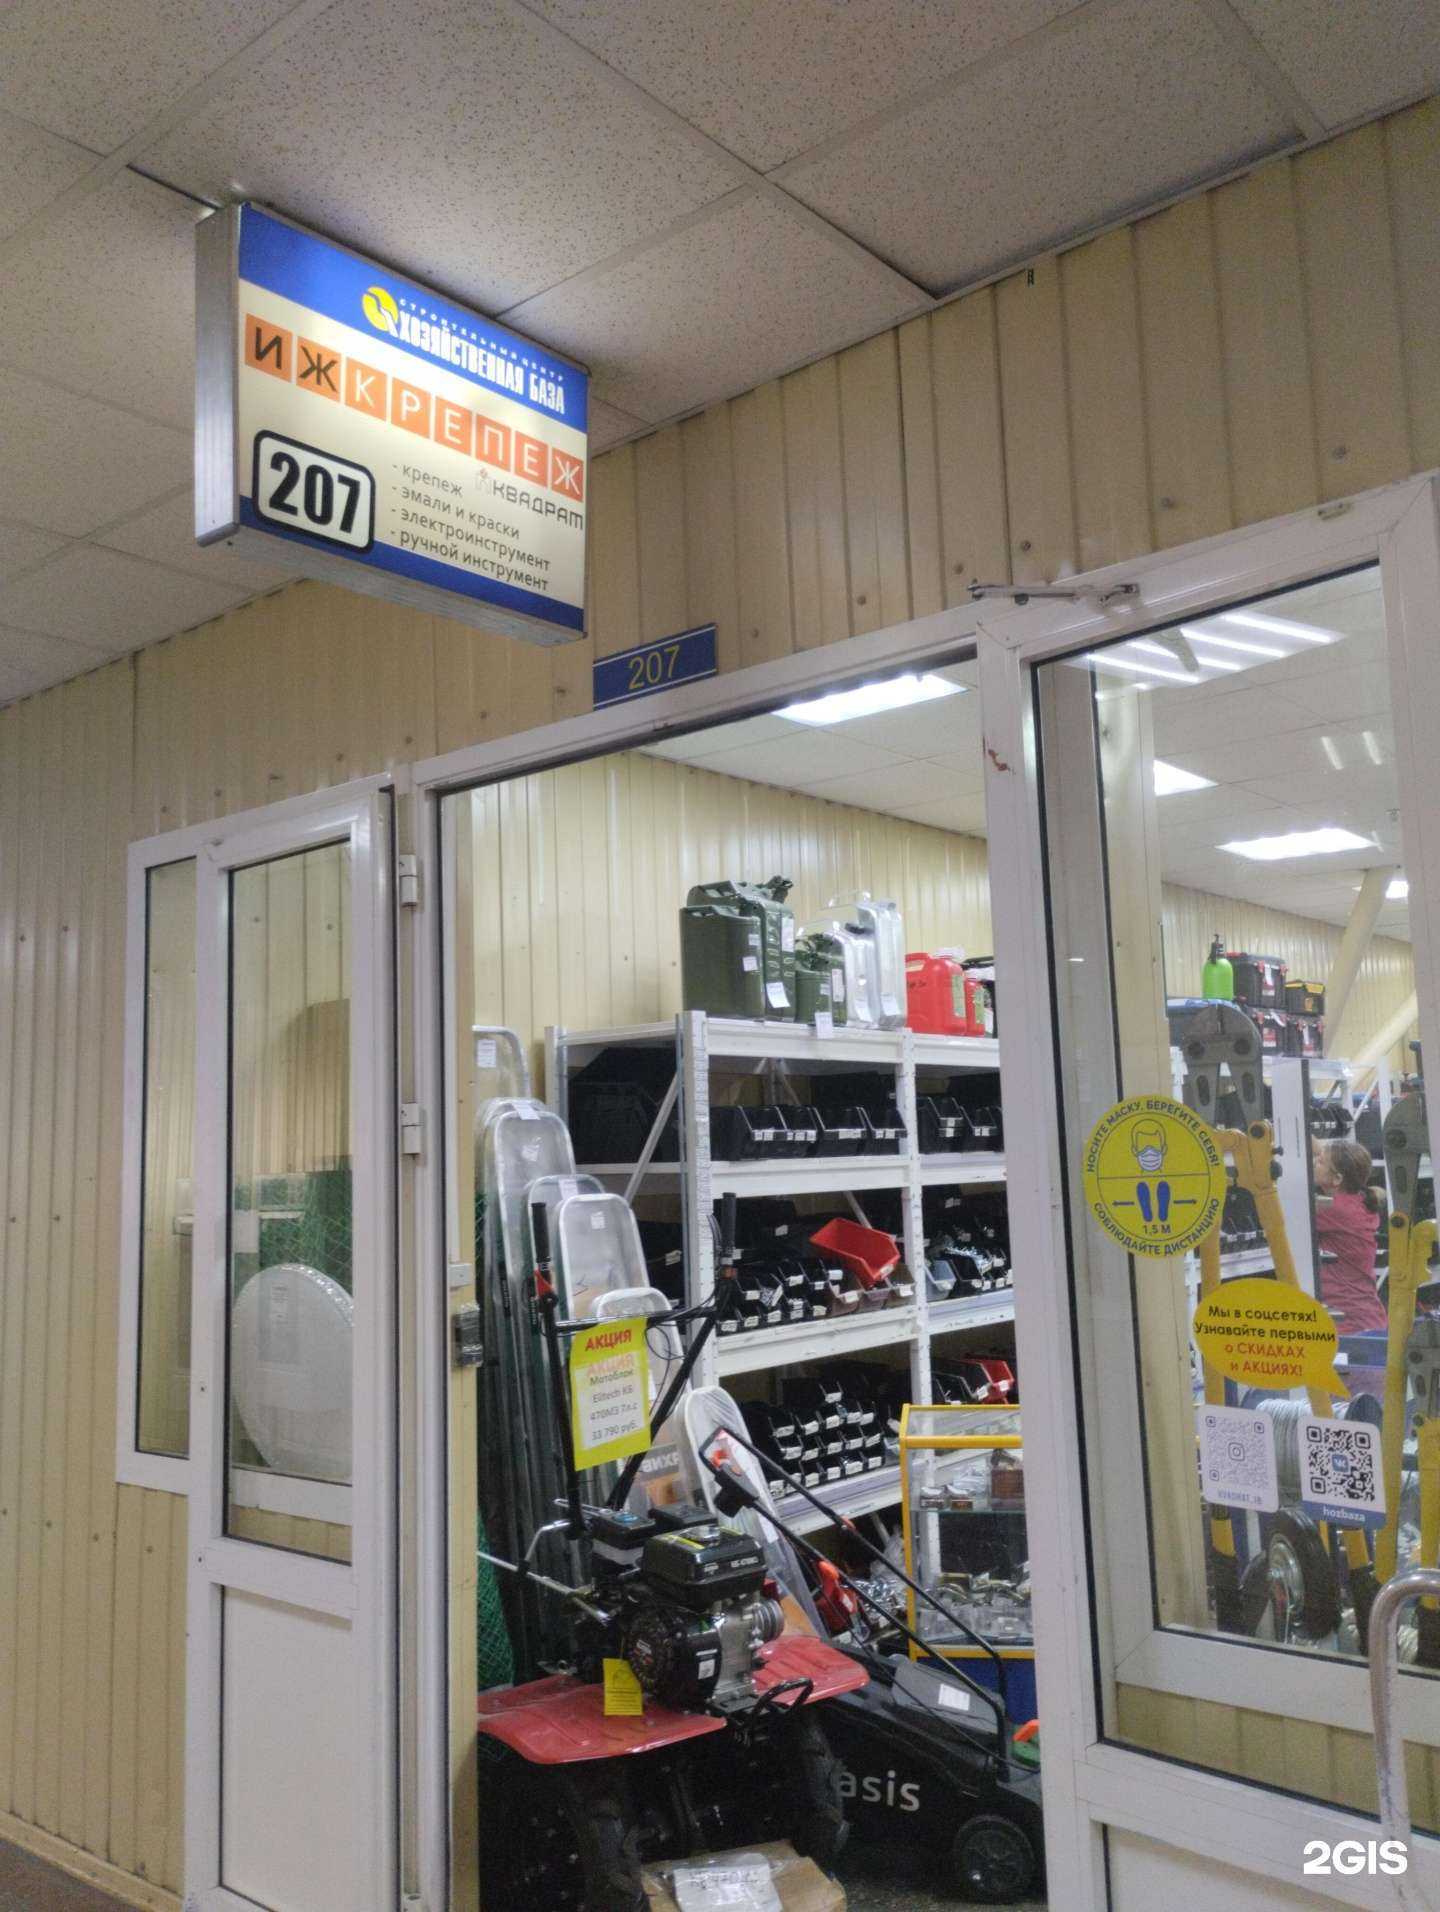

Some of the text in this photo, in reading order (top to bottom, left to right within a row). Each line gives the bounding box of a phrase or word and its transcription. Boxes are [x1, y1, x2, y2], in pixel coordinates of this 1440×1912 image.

[400, 299, 564, 382] СТРОИТЕЛЬНЫЙ ЦЕНТР
[400, 310, 565, 415] ХОЗЯЙСТВЕННАЯ БАЗА
[269, 451, 361, 534] 207
[402, 464, 463, 498] крепеж
[401, 486, 520, 540] эмали и краски
[401, 508, 550, 571] электроинструмент
[400, 530, 549, 591] ручной инструмент
[628, 645, 680, 689] 207
[1087, 1124, 1109, 1173] НОСИТЕ
[1146, 1100, 1201, 1134] БЕРЕГИТЕ
[1199, 1130, 1219, 1167] СЕБЯ!
[1094, 1198, 1220, 1256] СОБЛЮДАЙТЕ ДИСТАНЦИЮ
[585, 1329, 632, 1351] АКЦИЯ
[1194, 1322, 1336, 1342] Узнавайте первыми
[1208, 1305, 1317, 1323] Мы в соцсетях!
[1237, 1341, 1305, 1359] СКИДКАХ
[1243, 1362, 1303, 1377] АКЦИЯХ!
